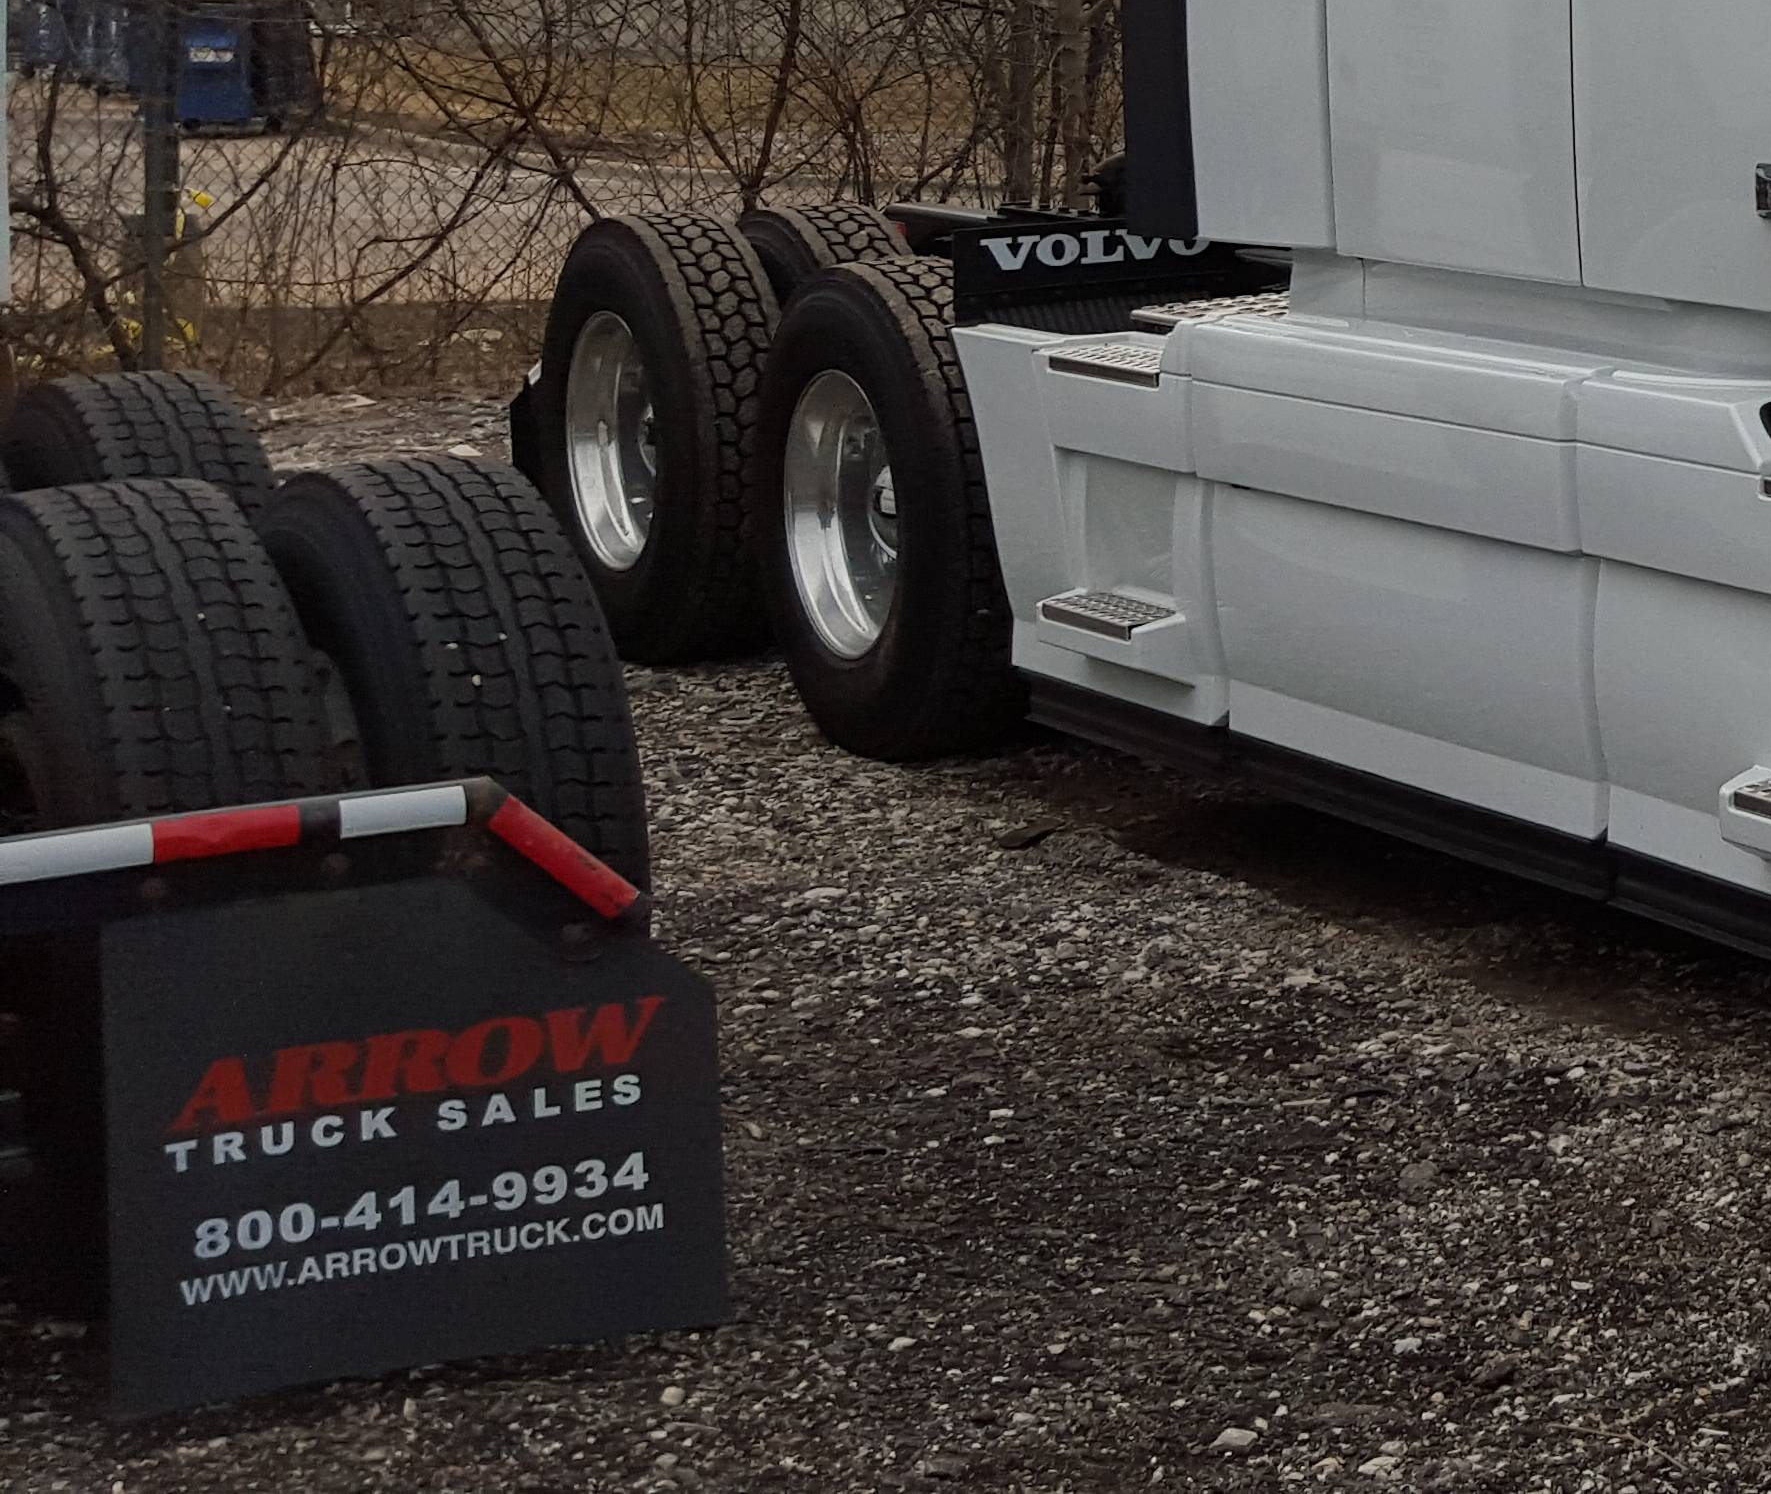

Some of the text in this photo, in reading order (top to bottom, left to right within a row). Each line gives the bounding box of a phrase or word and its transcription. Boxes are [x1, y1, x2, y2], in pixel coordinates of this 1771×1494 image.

[164, 995, 667, 1133] ARROW
[164, 1073, 643, 1172] TRUCK SALES
[180, 1202, 666, 1307] WWW.ARROWTRUCK.COM
[193, 1151, 650, 1258] 800-414-9934
